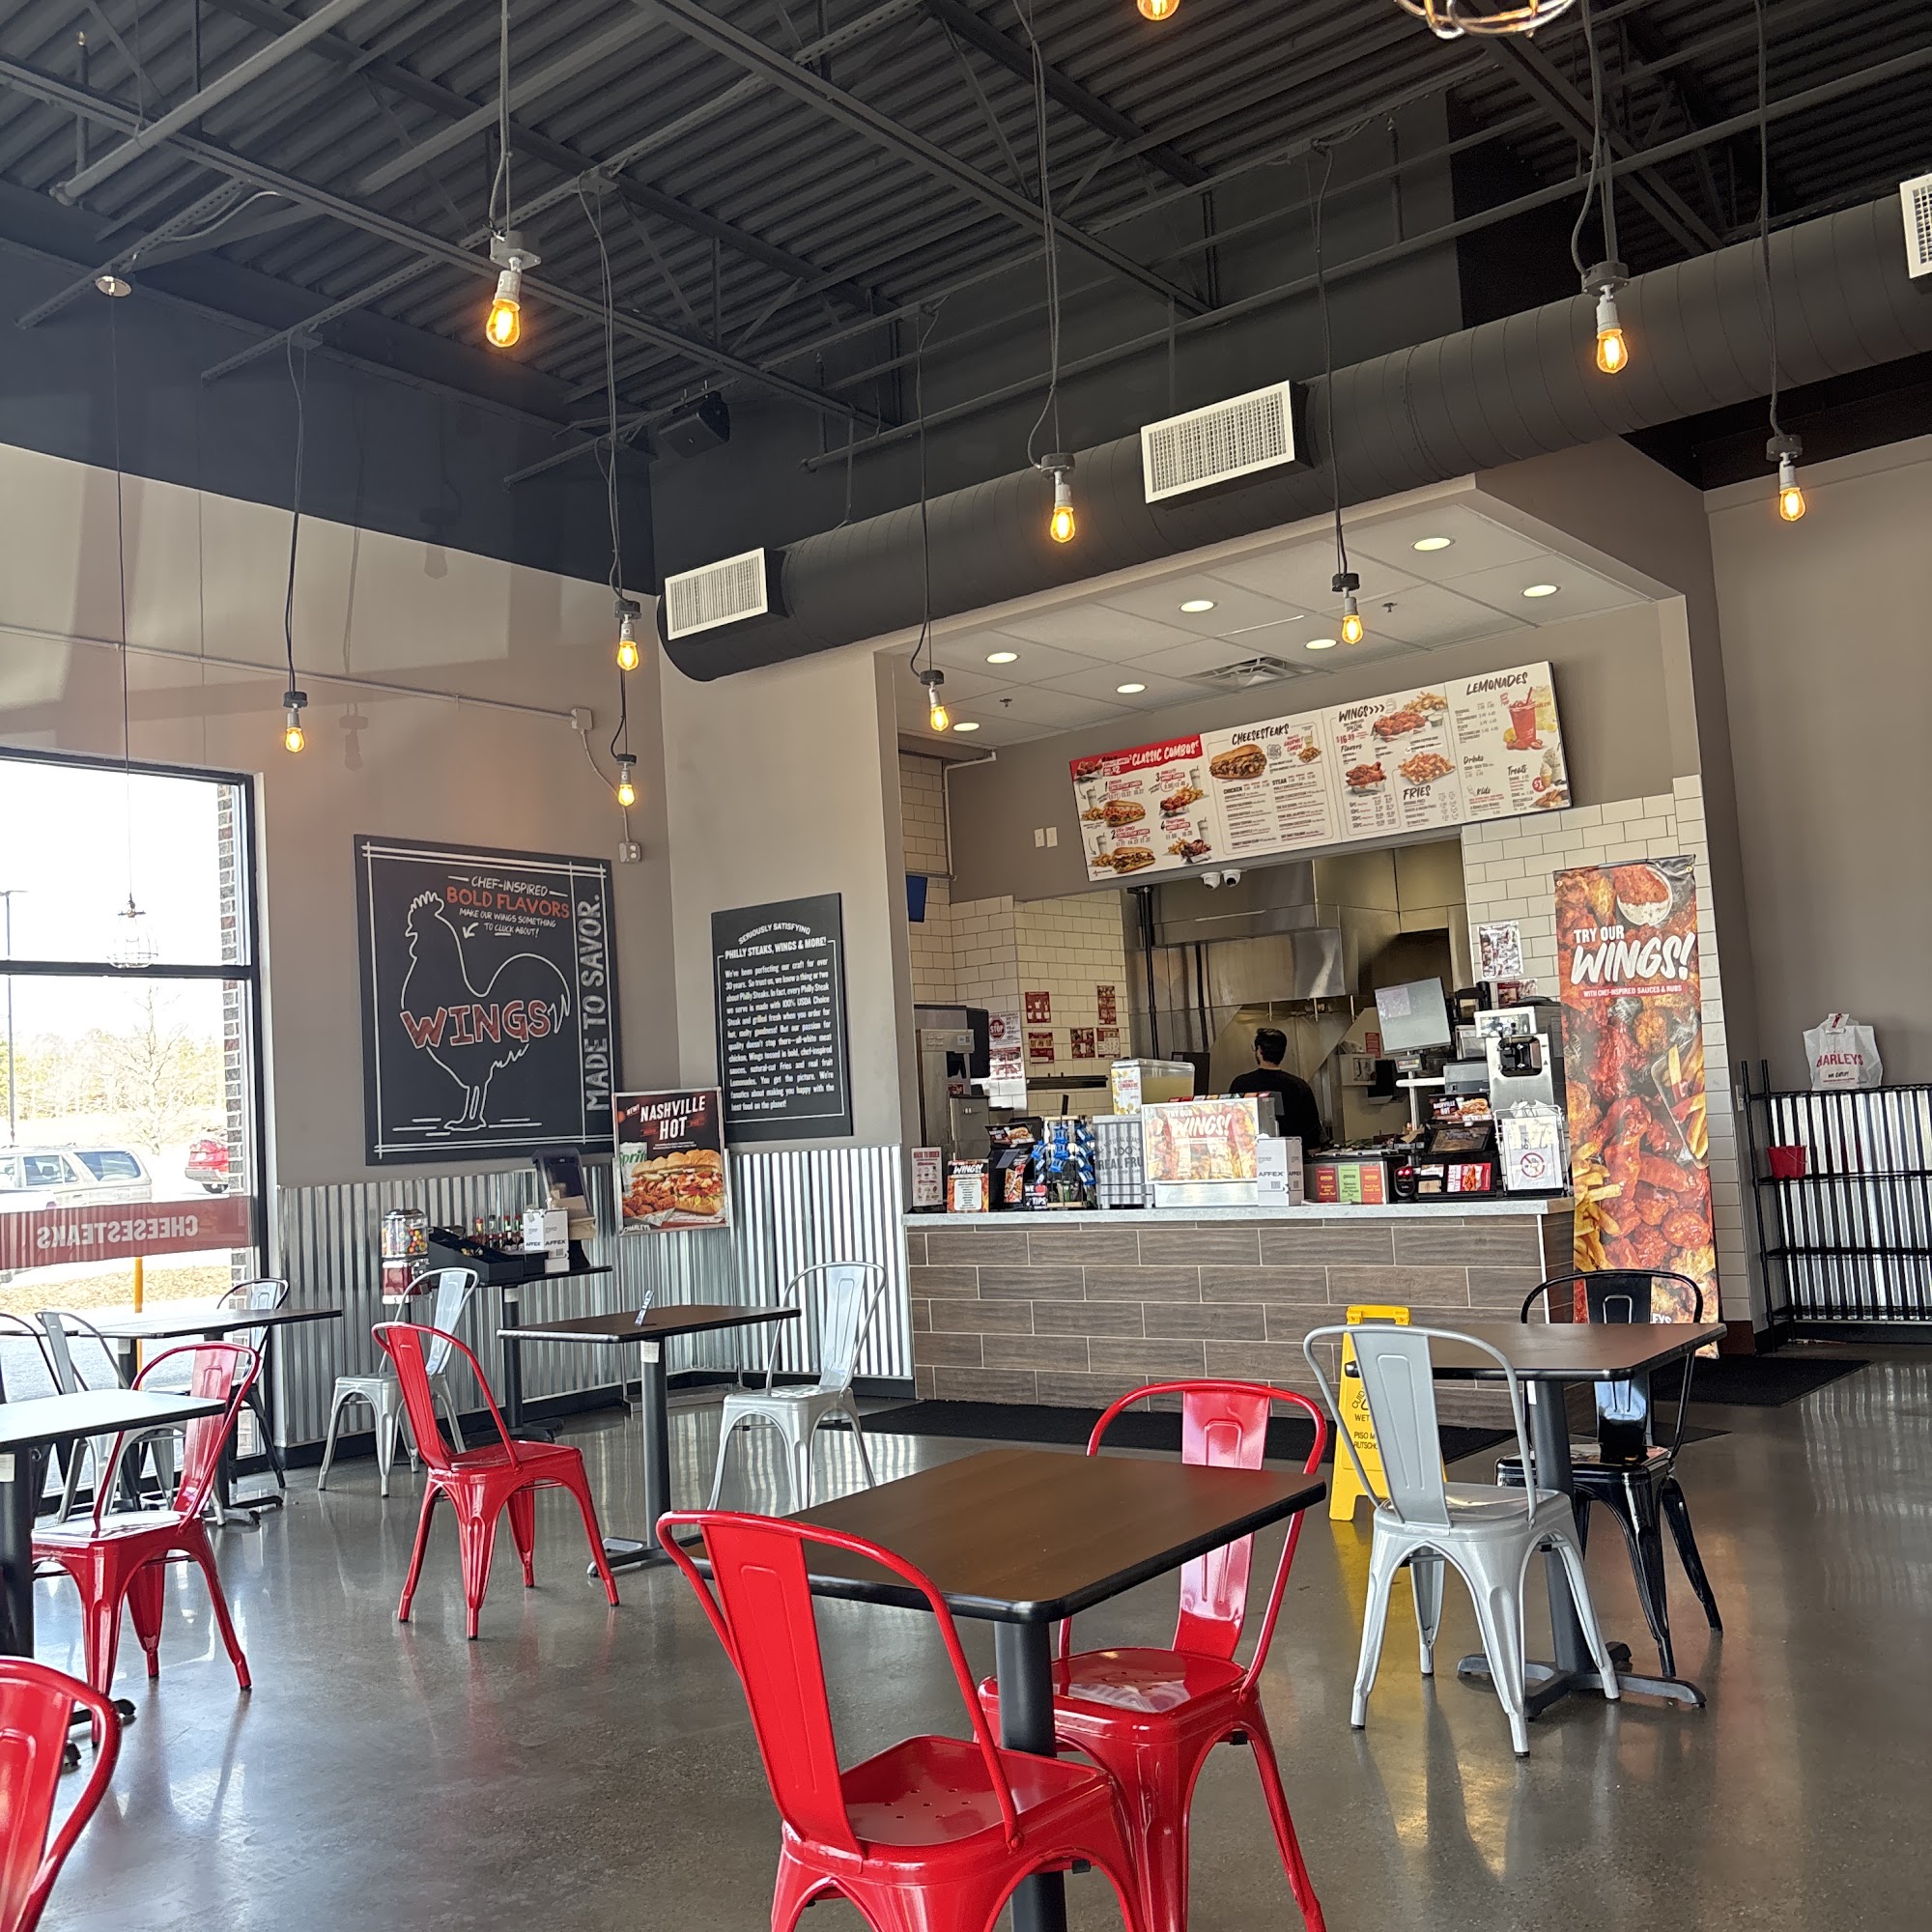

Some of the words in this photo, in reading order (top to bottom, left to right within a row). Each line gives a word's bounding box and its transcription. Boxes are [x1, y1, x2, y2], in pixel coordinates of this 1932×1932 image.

[1466, 672, 1528, 696] LEMONADES
[1339, 705, 1368, 723] WINGS
[1232, 724, 1290, 746] CHEESESTEAKS
[1131, 749, 1162, 766] CLASSIC
[1164, 743, 1196, 759] COMBOS
[1403, 785, 1431, 801] FRIES
[471, 875, 548, 896] CHEF-INSPIRED
[446, 887, 493, 908] BOLD
[497, 894, 570, 918] FLAVORS
[459, 908, 479, 918] MAKE
[480, 910, 493, 920] OUR
[494, 912, 517, 923] WINGS
[518, 916, 556, 927] SOMETHING
[484, 923, 494, 931] TO
[495, 923, 513, 933] CLUCK
[515, 926, 539, 938] ABOUT!
[577, 894, 605, 988] SAVOR.
[738, 923, 772, 945] SERIOUSLY
[773, 923, 811, 935] SATISFYING
[1574, 928, 1598, 944] TRY
[1600, 924, 1625, 942] OUR
[724, 948, 748, 960] PHILLY
[748, 945, 774, 956] STEAKS,
[775, 941, 797, 952] WINGS
[798, 940, 804, 950] &
[805, 936, 827, 948] MORE!
[1570, 931, 1695, 985] WINGS!
[1582, 989, 1597, 998] WITH
[1598, 987, 1636, 997] CHEF-INSPIRED
[400, 999, 552, 1050] WINGS
[582, 994, 608, 1034] TO
[584, 1037, 611, 1112] MADE
[639, 1095, 706, 1122] NASHVILLE
[659, 1116, 687, 1140] HOT
[1168, 1113, 1233, 1138] WINGS!
